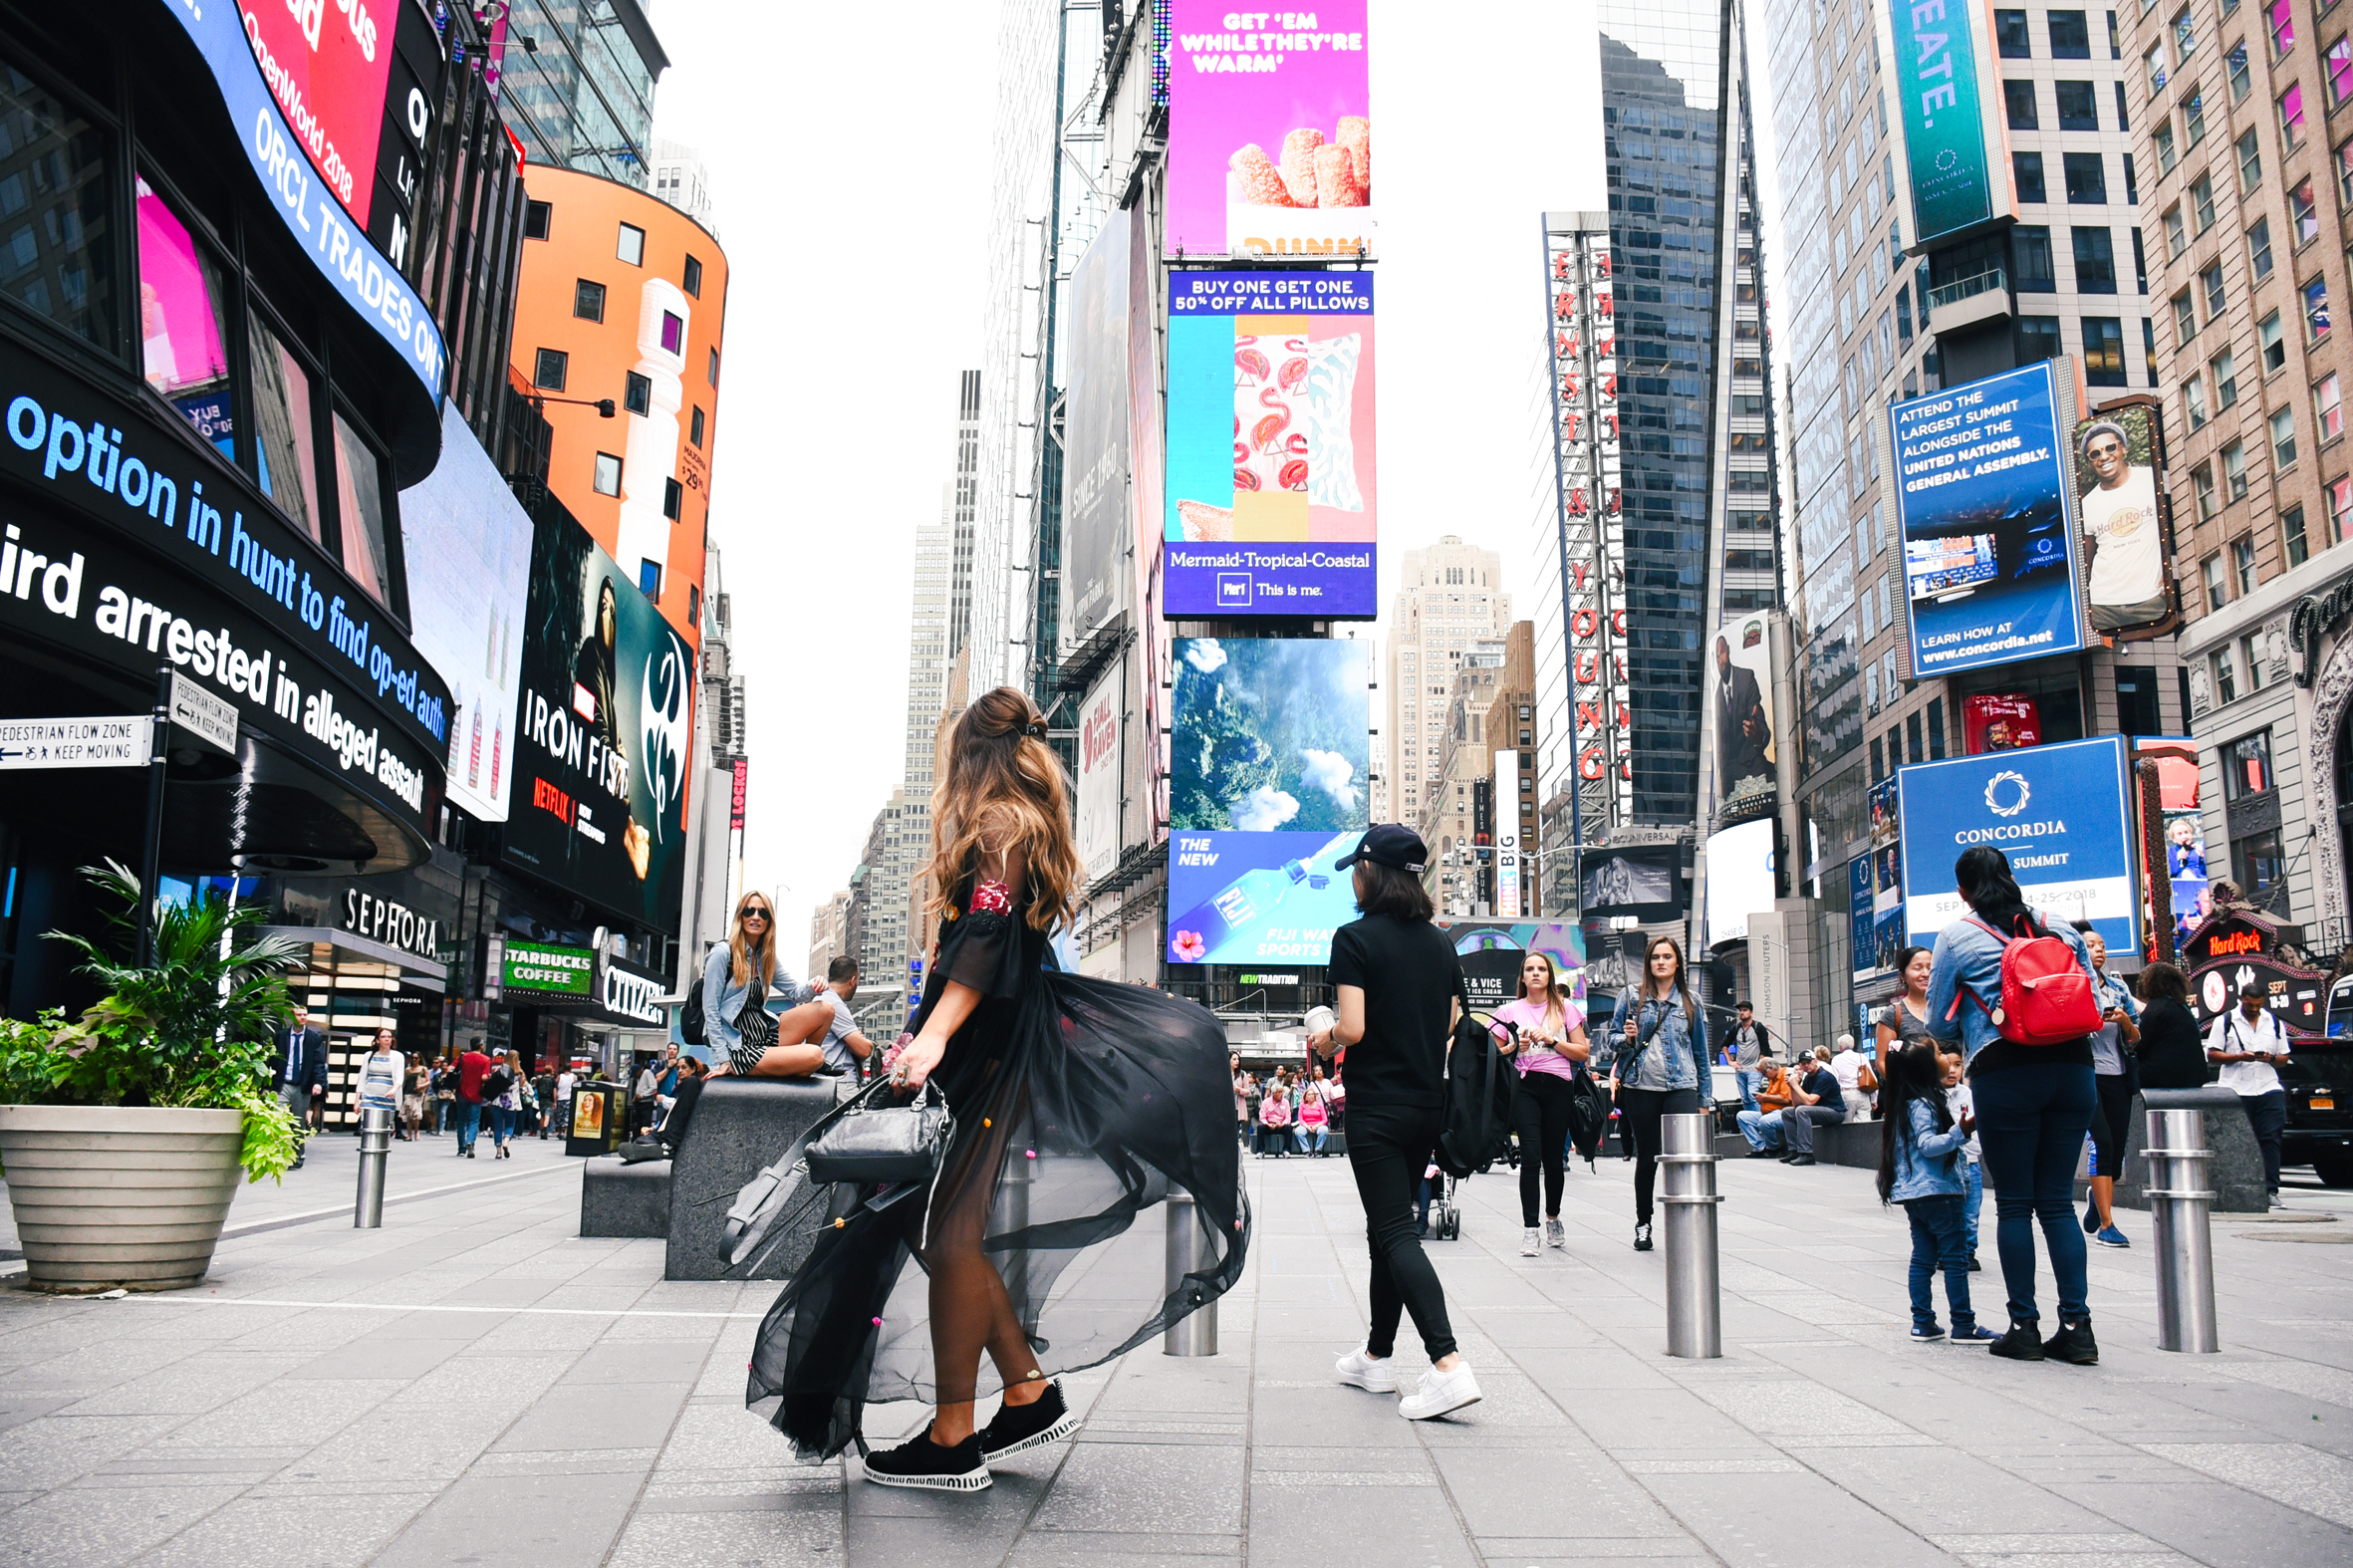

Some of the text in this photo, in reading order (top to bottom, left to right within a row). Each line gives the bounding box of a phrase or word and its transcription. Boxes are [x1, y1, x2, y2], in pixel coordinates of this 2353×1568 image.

[1223, 13, 1318, 30] GET 'EM
[1179, 33, 1259, 52] WHILE
[1911, 0, 1957, 129] EATE.
[245, 12, 353, 203] OpenWorld 2018
[256, 108, 310, 232] ORCL
[318, 201, 411, 341] TRADES
[414, 320, 436, 382] ON
[1192, 281, 1353, 294] BUY ONE GET ONE
[1176, 296, 1369, 310] 50% OFF ALL PILLOWS
[1900, 391, 1983, 423] ATTEND THE
[1901, 399, 2018, 441] LARGEST SUMMIT
[1903, 419, 2012, 458] ALONGSIDE THE
[1904, 436, 2021, 475] UNITED NATIONS
[1073, 465, 1095, 518] SINCE
[1098, 442, 1117, 491] 1960
[1906, 447, 2049, 492] GENERAL ASSEMBLY.
[1555, 252, 1604, 779] ERNST & YOUNG
[2097, 505, 2153, 536] Hard Rock
[7, 395, 177, 528] option
[187, 480, 222, 556] in
[229, 511, 297, 611] hunt
[301, 571, 324, 631] to
[329, 595, 369, 668] find
[370, 645, 417, 712] op-ed
[1171, 552, 1370, 570] Mermaid-Tropical-Coastal
[2028, 553, 2064, 565] CONCORDIA
[1256, 583, 1283, 596] This
[1287, 584, 1297, 596] is
[1301, 587, 1323, 596] me.
[1922, 622, 2012, 649] LEARN HOW AT
[1923, 630, 2052, 663] www.concordia.net
[0, 523, 423, 814] ird arrested in alleged assault
[177, 681, 236, 727] PEDESTRIAN FLOW ZONE
[69, 724, 99, 739] FLOW
[103, 723, 132, 739] ZONE
[202, 717, 234, 746] KEEP MOVING
[524, 688, 583, 771] IRON
[588, 735, 630, 800] FIST
[54, 743, 131, 760] KEEP MOVING
[533, 777, 592, 824] NETFLIX NOW
[577, 819, 606, 845] STREAMING
[1179, 839, 1211, 851] THE
[1955, 820, 2067, 844] CONCORDIA
[1177, 853, 1219, 866] NEW
[1500, 836, 1514, 866] BIG
[2013, 853, 2069, 870] SUMMIT
[1216, 886, 1255, 927] FIJI
[2065, 889, 2096, 901] 2018
[347, 888, 436, 957] SEPHORA
[1266, 928, 1297, 940] FIJI
[1721, 927, 1737, 938] CHASE
[1256, 943, 1320, 956] SPORTS
[2209, 928, 2261, 956] Hard Rock
[513, 966, 572, 984] COFFEE
[1479, 978, 1502, 988] VICE
[2268, 980, 2287, 994] SEPT
[603, 965, 665, 1025] CITIZEN
[1040, 1425, 1069, 1443] miu
[946, 1477, 978, 1488] miu
